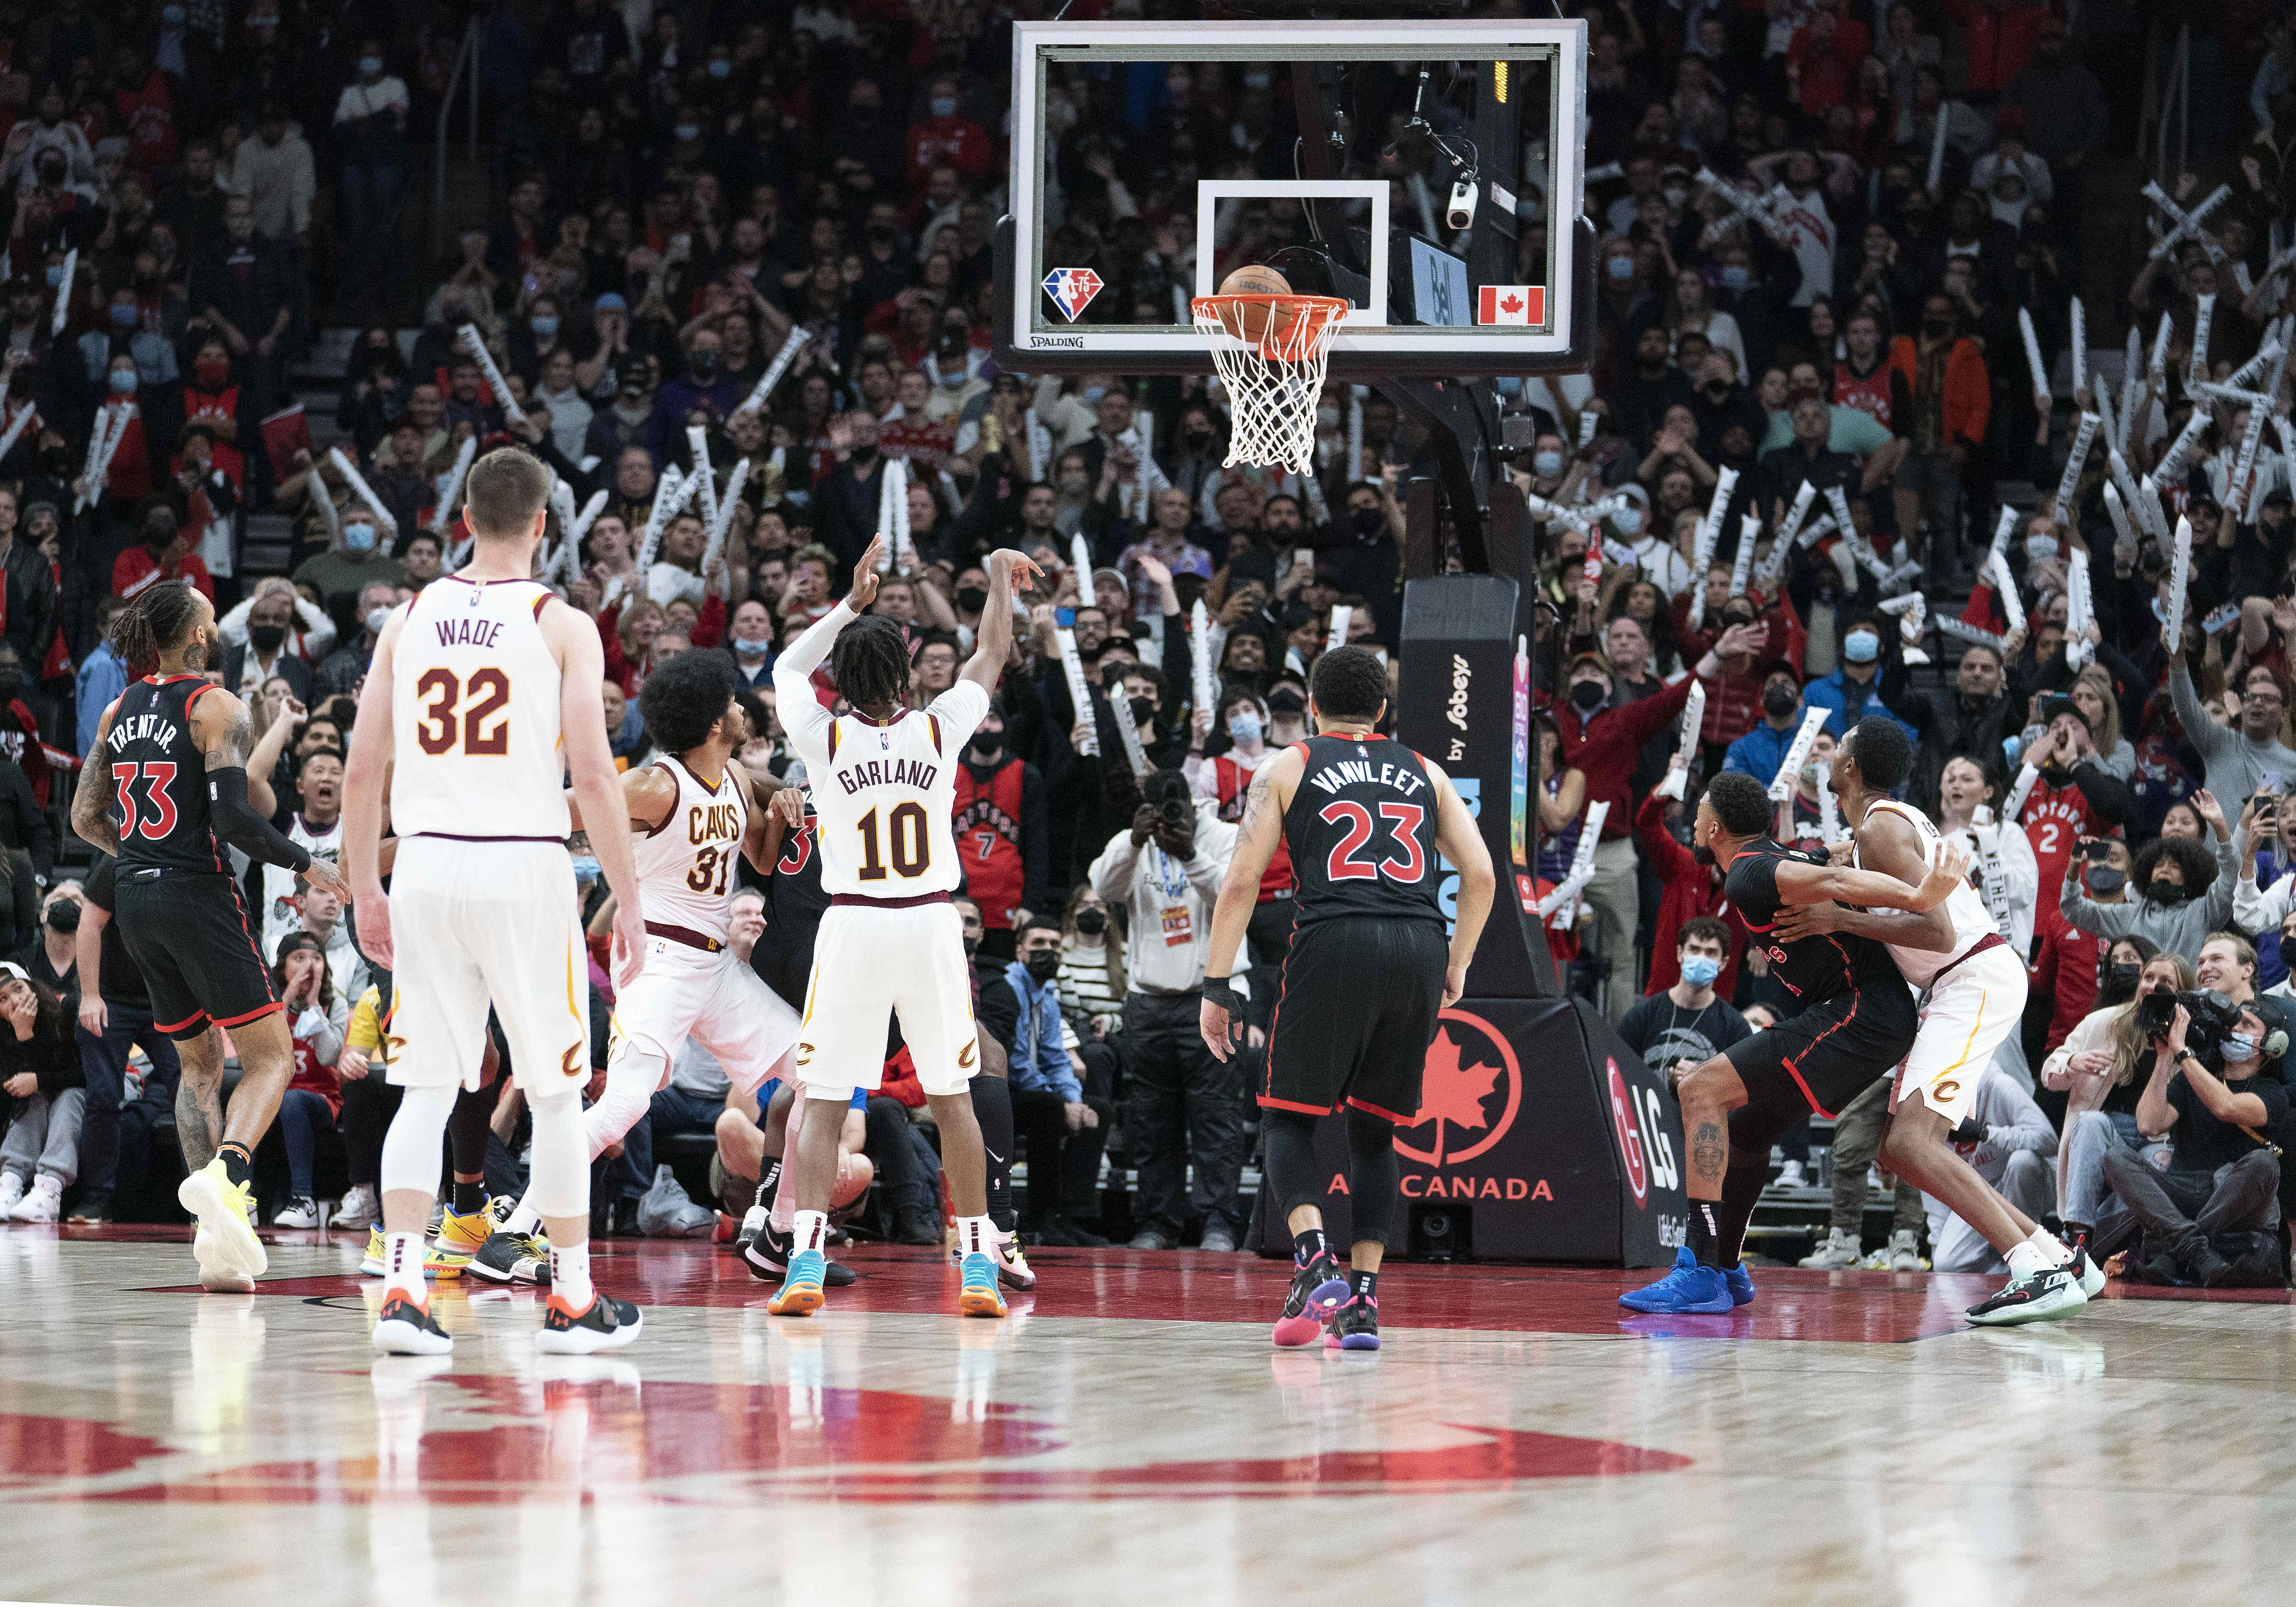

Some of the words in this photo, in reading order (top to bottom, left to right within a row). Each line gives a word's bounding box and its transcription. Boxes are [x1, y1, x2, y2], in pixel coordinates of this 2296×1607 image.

[1078, 276, 1091, 293] 75
[1030, 336, 1083, 348] SPALDING
[435, 619, 504, 648] WADE
[418, 666, 510, 756] 32
[1446, 653, 1472, 731] Sobeys
[107, 714, 158, 754] TRENT
[154, 719, 177, 755] JR.
[1446, 737, 1466, 761] by
[837, 758, 937, 796] GARLAND
[1310, 759, 1426, 797] VANVLEET
[112, 761, 177, 841] 33
[2024, 800, 2086, 834] APTORS
[689, 804, 740, 845] CAVS
[857, 801, 930, 881] 10
[1319, 800, 1425, 884] 23
[2039, 823, 2059, 853] 2
[975, 832, 996, 860] 7
[686, 845, 730, 896] 31
[1989, 874, 2006, 905] THE
[1631, 1084, 1679, 1192] LG
[1400, 1174, 1553, 1201] CANADA
